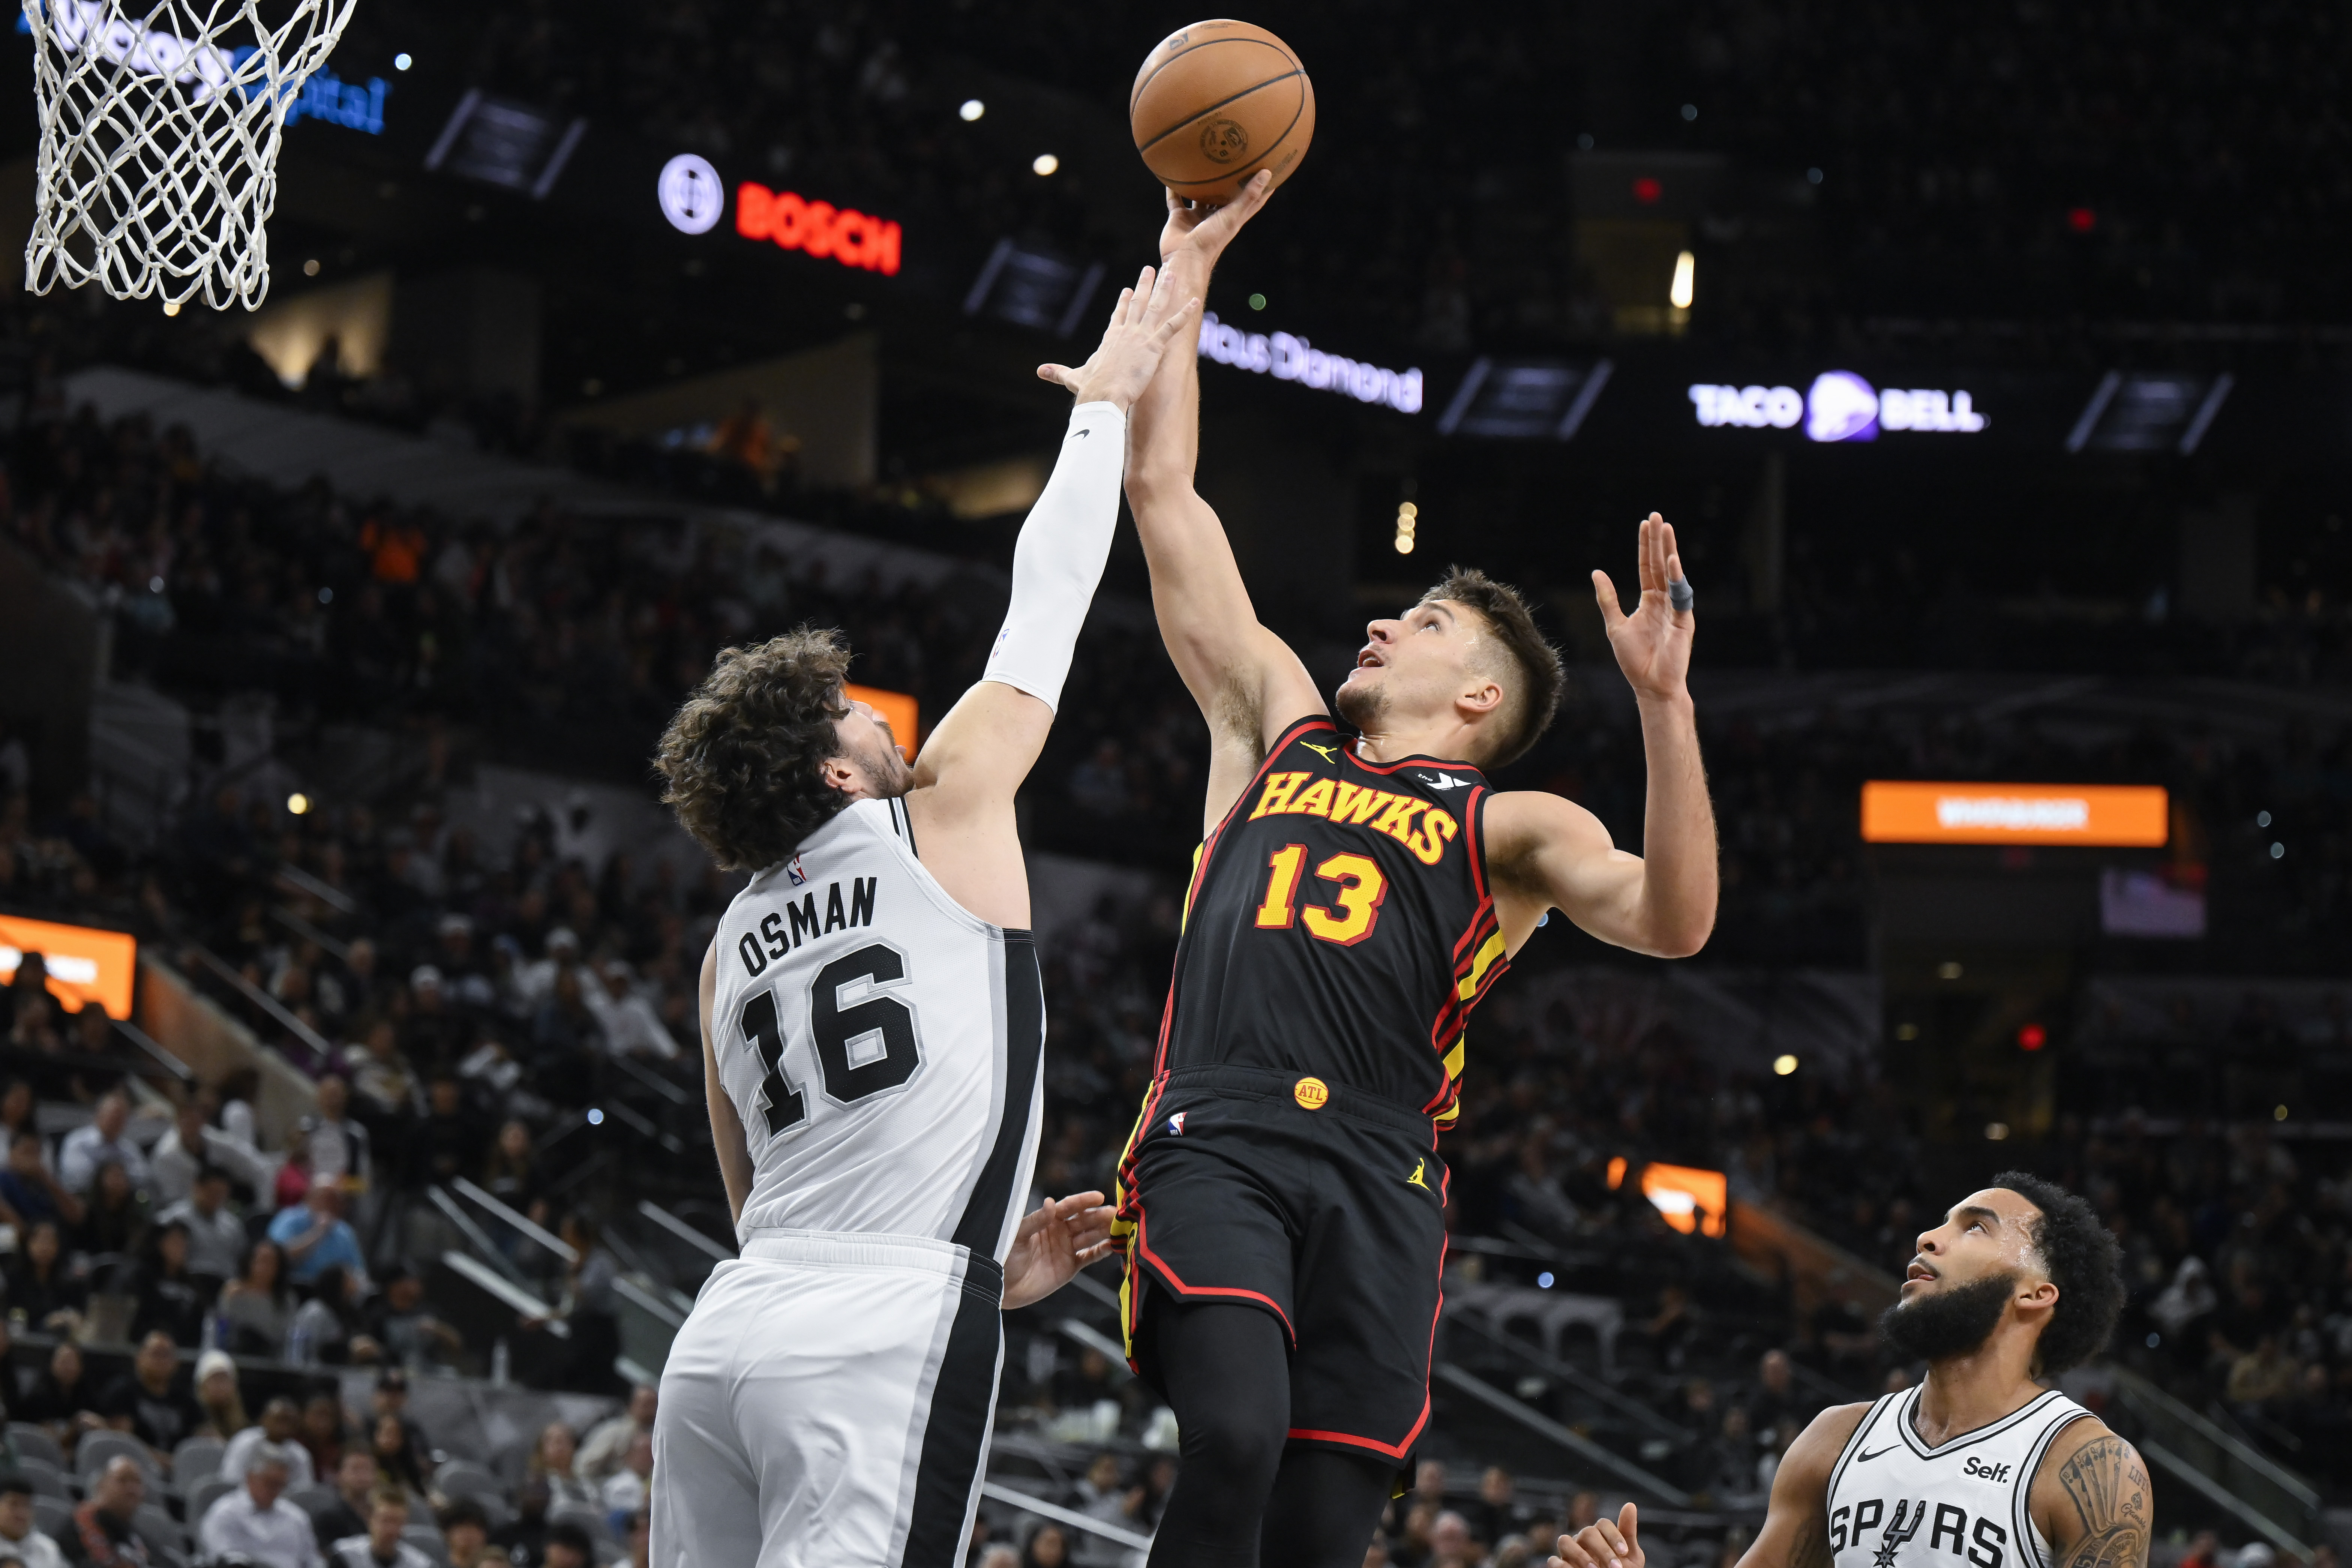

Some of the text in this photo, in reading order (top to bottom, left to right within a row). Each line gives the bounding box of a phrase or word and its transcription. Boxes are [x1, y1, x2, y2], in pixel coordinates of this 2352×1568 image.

[736, 180, 902, 277] BOSCH
[1270, 330, 1422, 413] Diamond
[1689, 384, 1990, 432] TACO BELL
[1247, 771, 1458, 865] HAWKS
[739, 877, 877, 977] OSMAN
[1254, 843, 1388, 947] 13
[736, 936, 927, 1145] 16
[1298, 1085, 1323, 1101] ATL
[1963, 1457, 2011, 1484] Self.
[1831, 1499, 2006, 1568] SPURS
